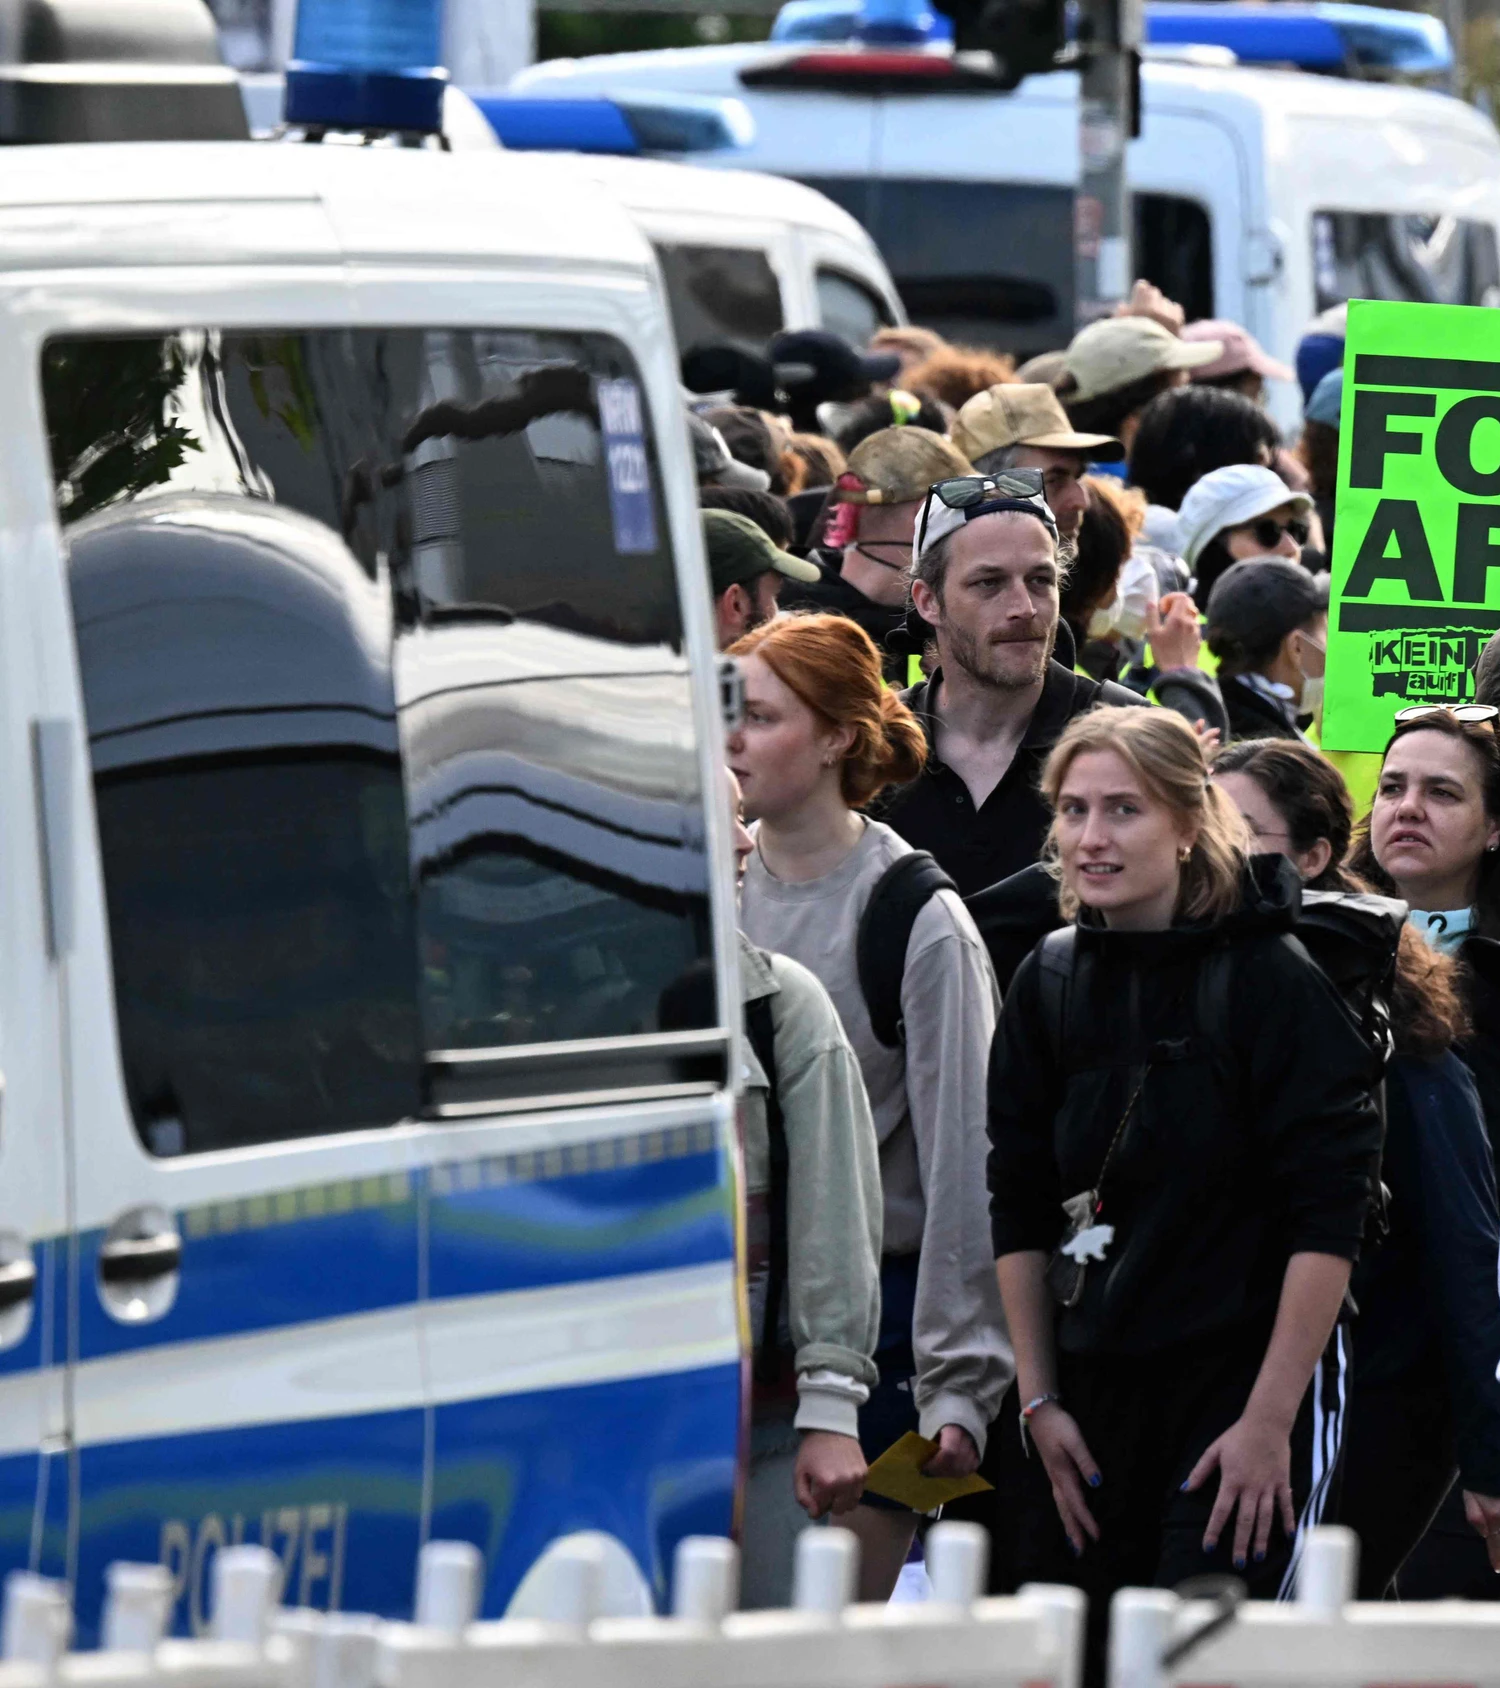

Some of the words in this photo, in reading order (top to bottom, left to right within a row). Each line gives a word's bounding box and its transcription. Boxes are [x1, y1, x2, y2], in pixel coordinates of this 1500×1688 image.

[1375, 639, 1464, 667] KEIN
[1408, 672, 1457, 692] auf
[160, 1501, 348, 1638] POZEI
